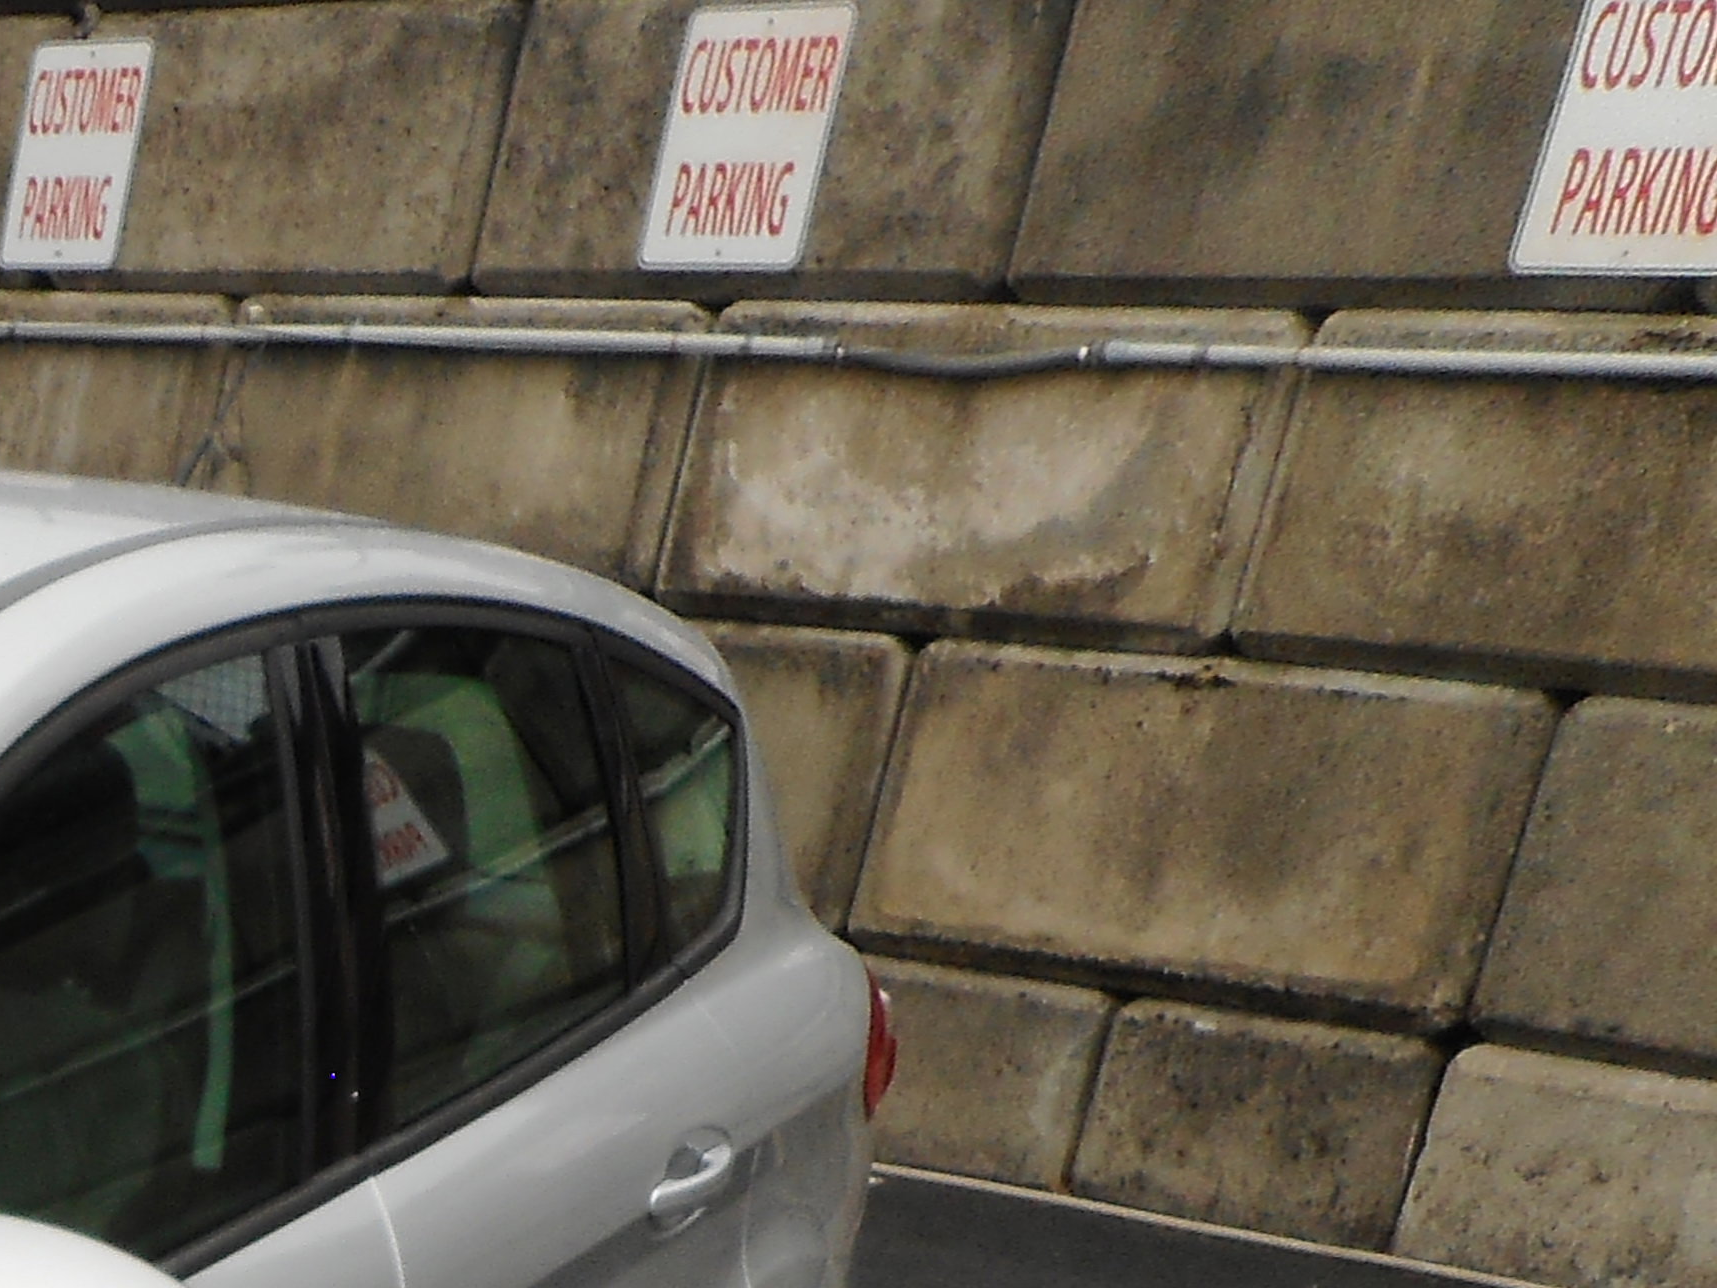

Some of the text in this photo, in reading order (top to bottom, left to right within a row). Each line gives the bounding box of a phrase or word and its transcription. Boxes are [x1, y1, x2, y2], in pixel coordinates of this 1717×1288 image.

[29, 67, 142, 135] CUSTOMER
[680, 34, 840, 115] CUSTOMER
[18, 176, 113, 241] PARKING
[665, 160, 796, 237] PARKING
